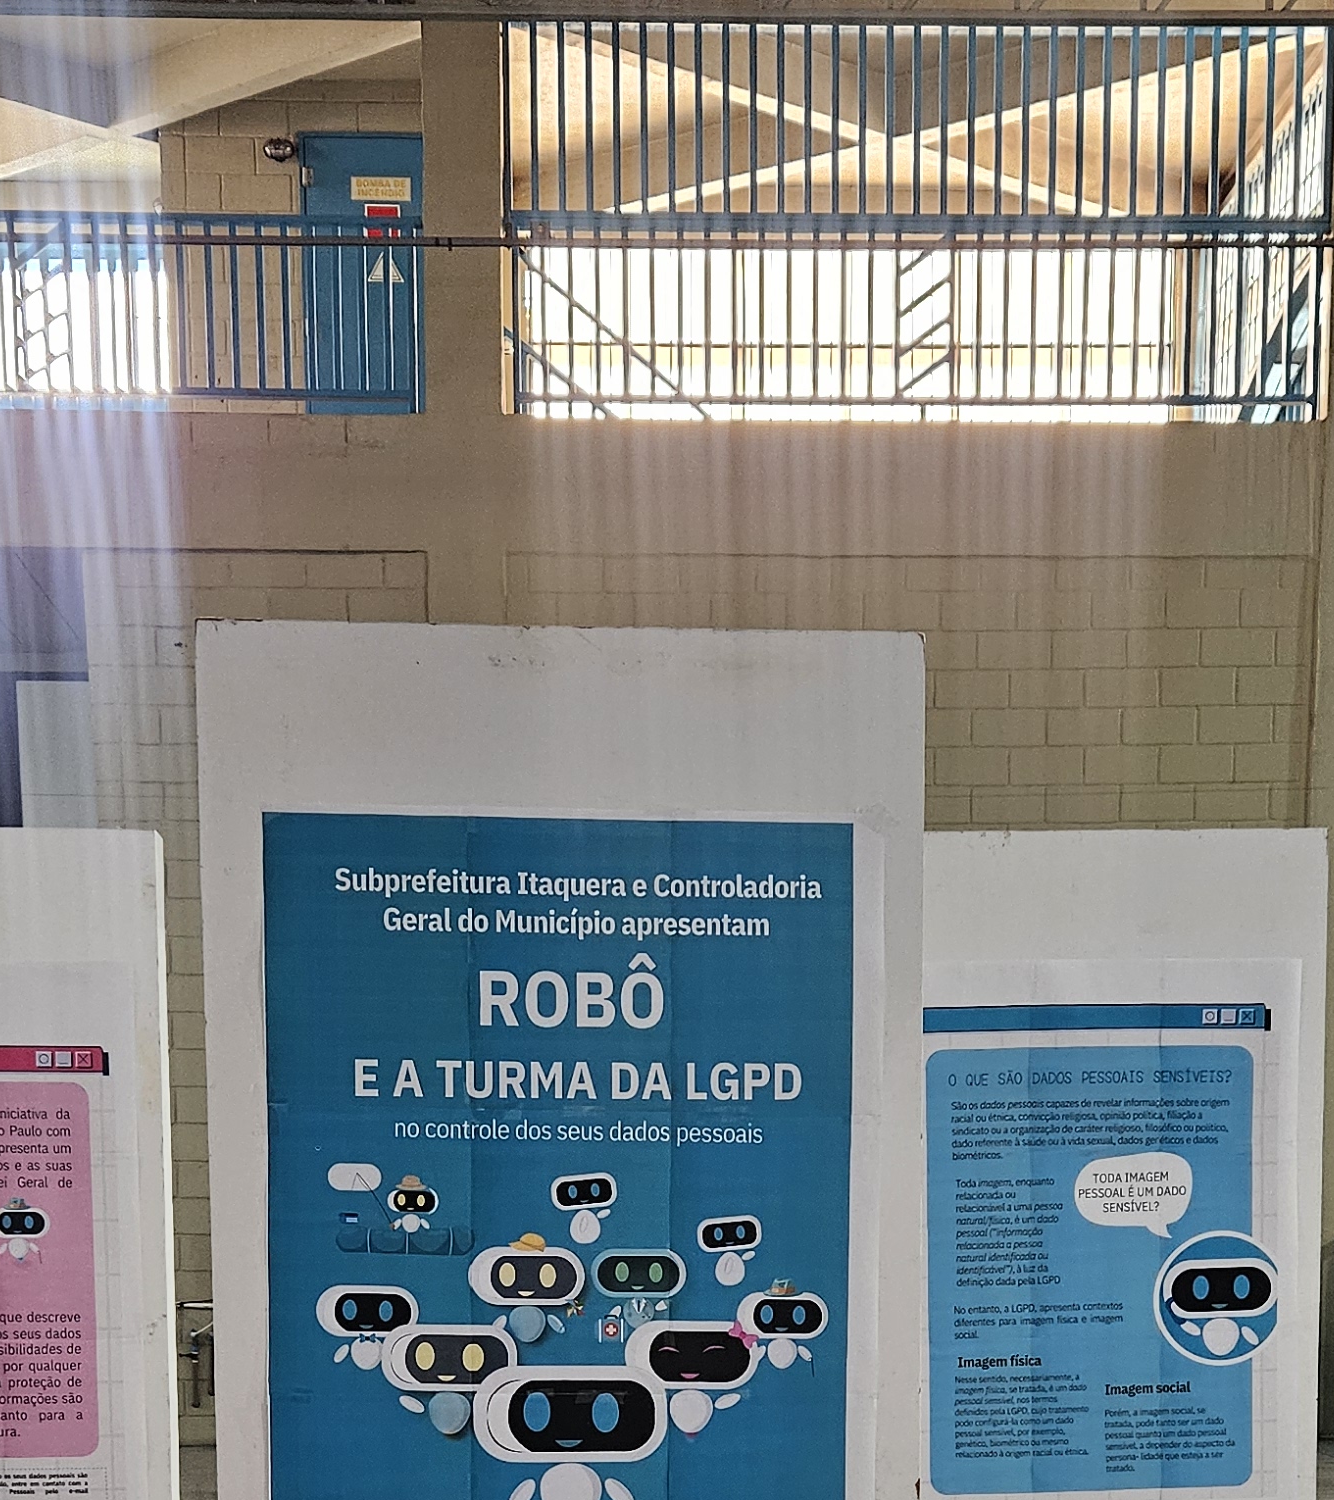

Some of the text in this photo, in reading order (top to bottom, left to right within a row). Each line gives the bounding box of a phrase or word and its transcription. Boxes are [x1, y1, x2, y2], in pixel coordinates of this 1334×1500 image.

[356, 179, 406, 188] BOMBA DE
[334, 866, 822, 902] Subprefeitura Itaquera e Controladoria
[383, 906, 452, 932] Geral
[457, 907, 489, 933] do
[621, 913, 769, 941] apresentam
[479, 952, 664, 1029] ROBÔ
[354, 1058, 802, 1101] E A TURMA DA LGPD
[947, 1067, 1232, 1087] O QUE SÃO DADOS PESSOAIS SENSÍVEIS?
[55, 1107, 70, 1120] da
[9, 1124, 42, 1137] Paulo
[45, 1127, 71, 1137] com
[394, 1118, 763, 1147] no controle dos seus dados pessoais
[52, 1144, 72, 1154] um
[14, 1161, 22, 1171] e
[26, 1161, 40, 1171] as
[45, 1161, 72, 1172] suas
[16, 1175, 48, 1188] Geral
[57, 1175, 73, 1189] de
[954, 1178, 977, 1188] Toda
[1092, 1170, 1168, 1184] TODA IMAGEM
[1078, 1184, 1187, 1199] PESSOAL É UM DADO
[1102, 1199, 1160, 1213] SENSÍVEL?
[26, 1310, 81, 1323] descreve
[12, 1329, 42, 1340] seus
[44, 1326, 82, 1339] dados
[66, 1342, 82, 1354] de
[2, 1362, 24, 1375] por
[27, 1358, 82, 1374] qualquer
[957, 1354, 1042, 1370] Imagem física
[1104, 1380, 1191, 1397] Imagem social
